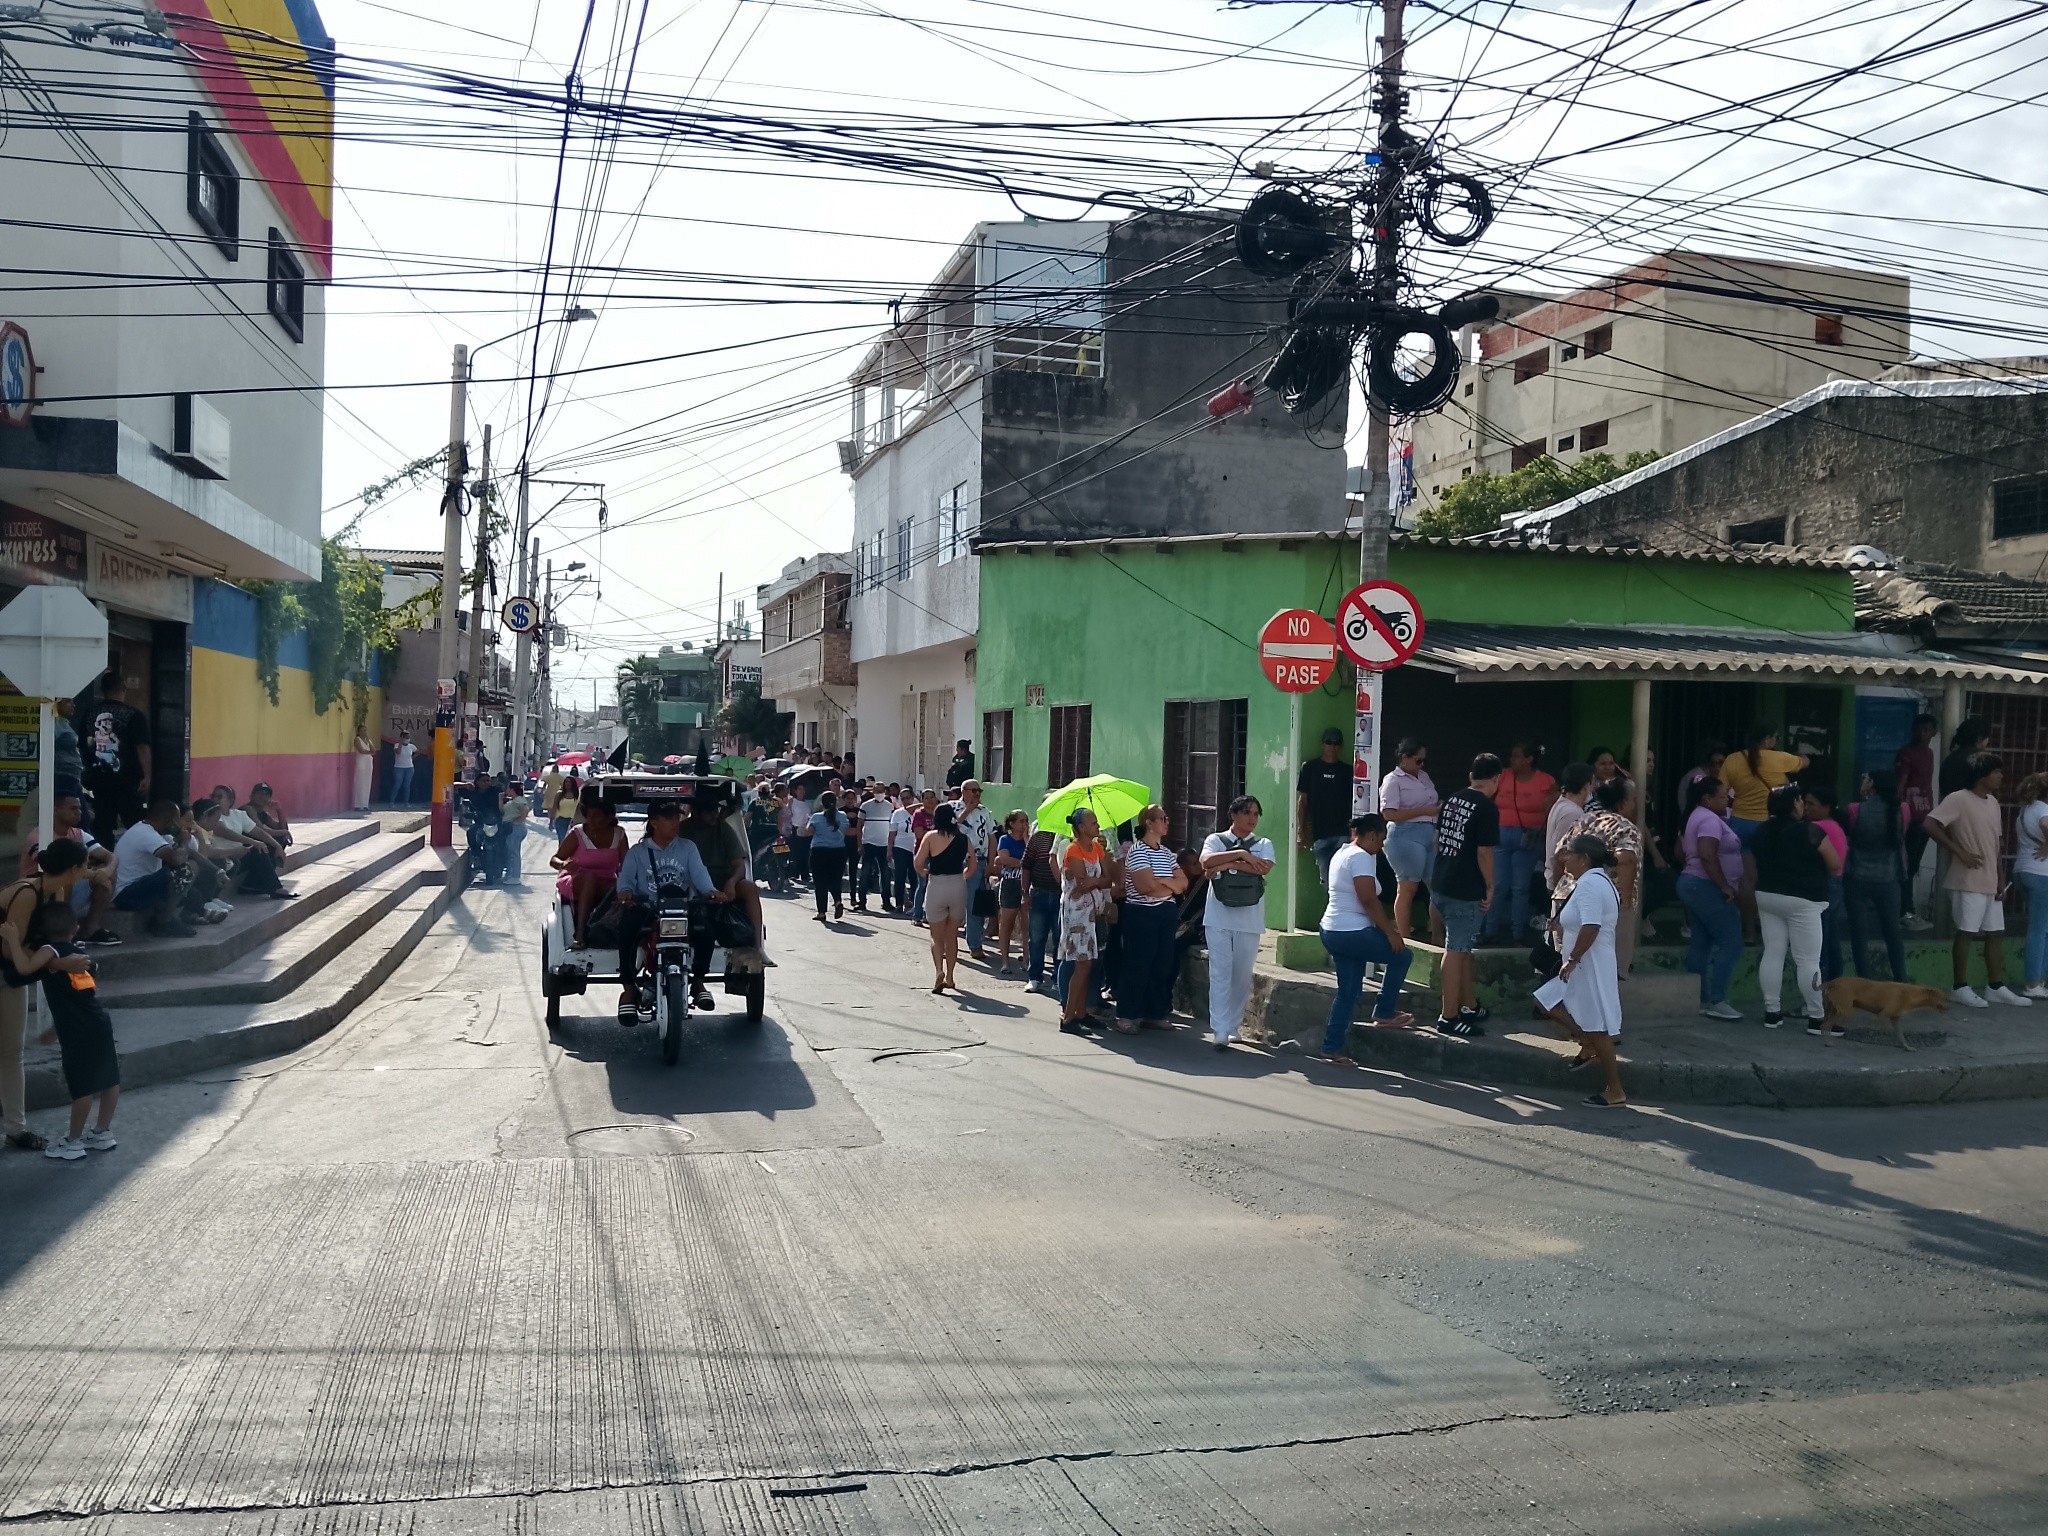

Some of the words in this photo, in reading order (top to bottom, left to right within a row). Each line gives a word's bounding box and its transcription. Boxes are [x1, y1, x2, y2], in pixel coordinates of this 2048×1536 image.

[9, 521, 43, 537] LICORES
[0, 539, 57, 568] xpress
[1288, 617, 1310, 637] NO
[1276, 665, 1320, 685] PASE
[390, 718, 431, 731] RAM
[9, 738, 28, 752] 24
[9, 776, 28, 789] 24
